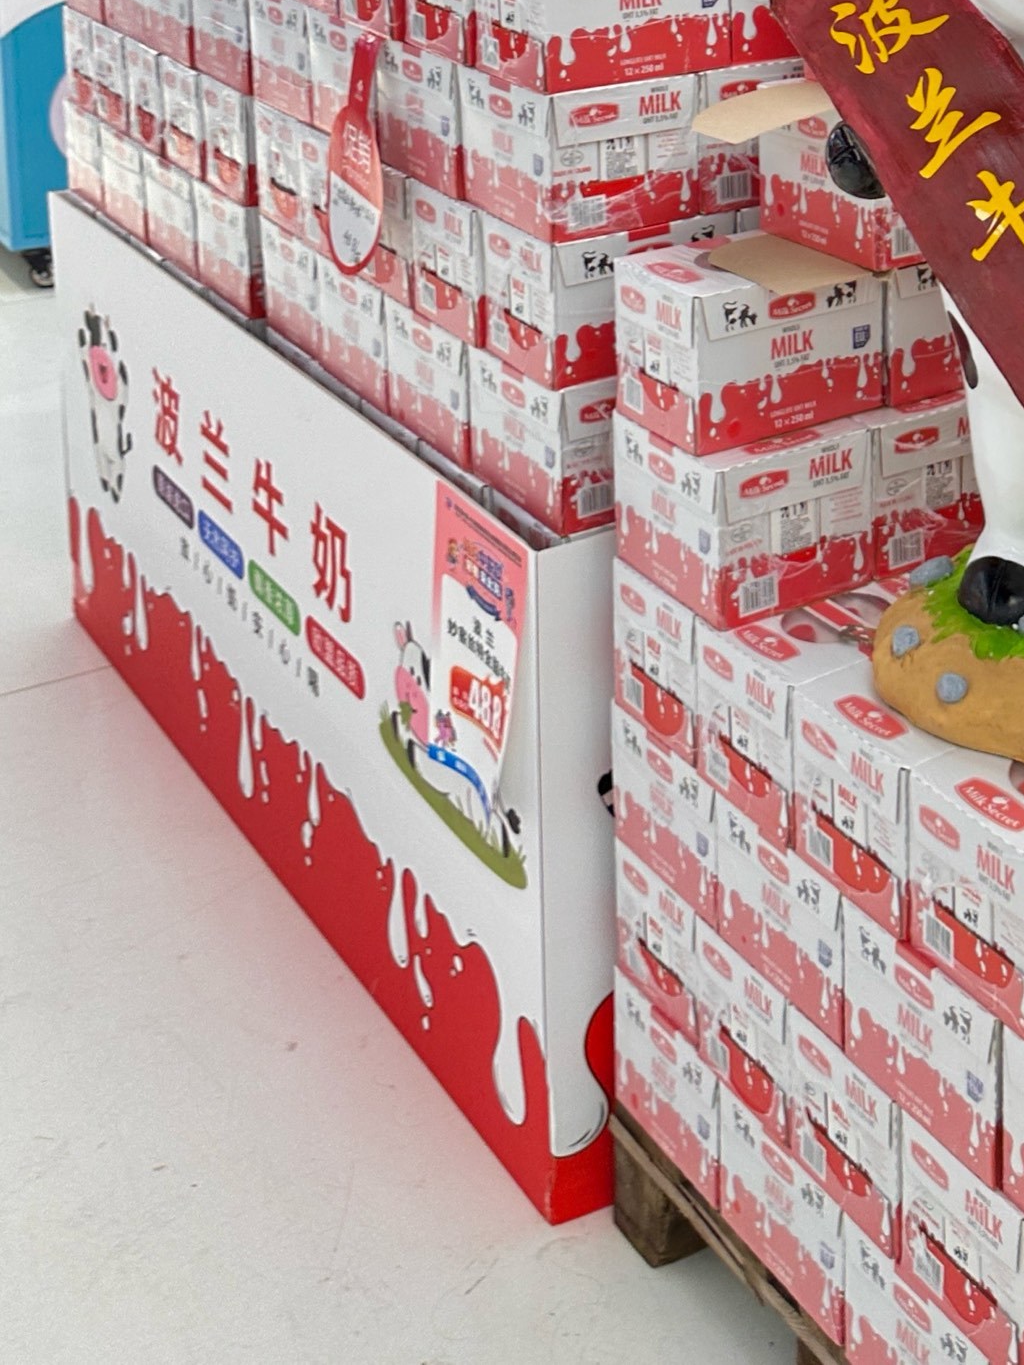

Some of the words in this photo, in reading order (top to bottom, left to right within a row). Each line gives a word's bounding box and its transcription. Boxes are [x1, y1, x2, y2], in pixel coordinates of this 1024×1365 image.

[639, 91, 682, 117] MILK
[656, 301, 682, 331] MILK
[771, 329, 814, 360] MILK
[808, 447, 854, 480] MILK
[151, 366, 353, 624] 波兰牛奶
[745, 672, 775, 713] MILK
[842, 701, 863, 719] Milk
[862, 716, 892, 737] Secret
[850, 751, 885, 797] MILK
[963, 785, 987, 807] Milk
[983, 803, 1020, 827] Secret
[976, 844, 1015, 894] MILK
[843, 1072, 879, 1118] MILK
[963, 1188, 1004, 1246] MILK
